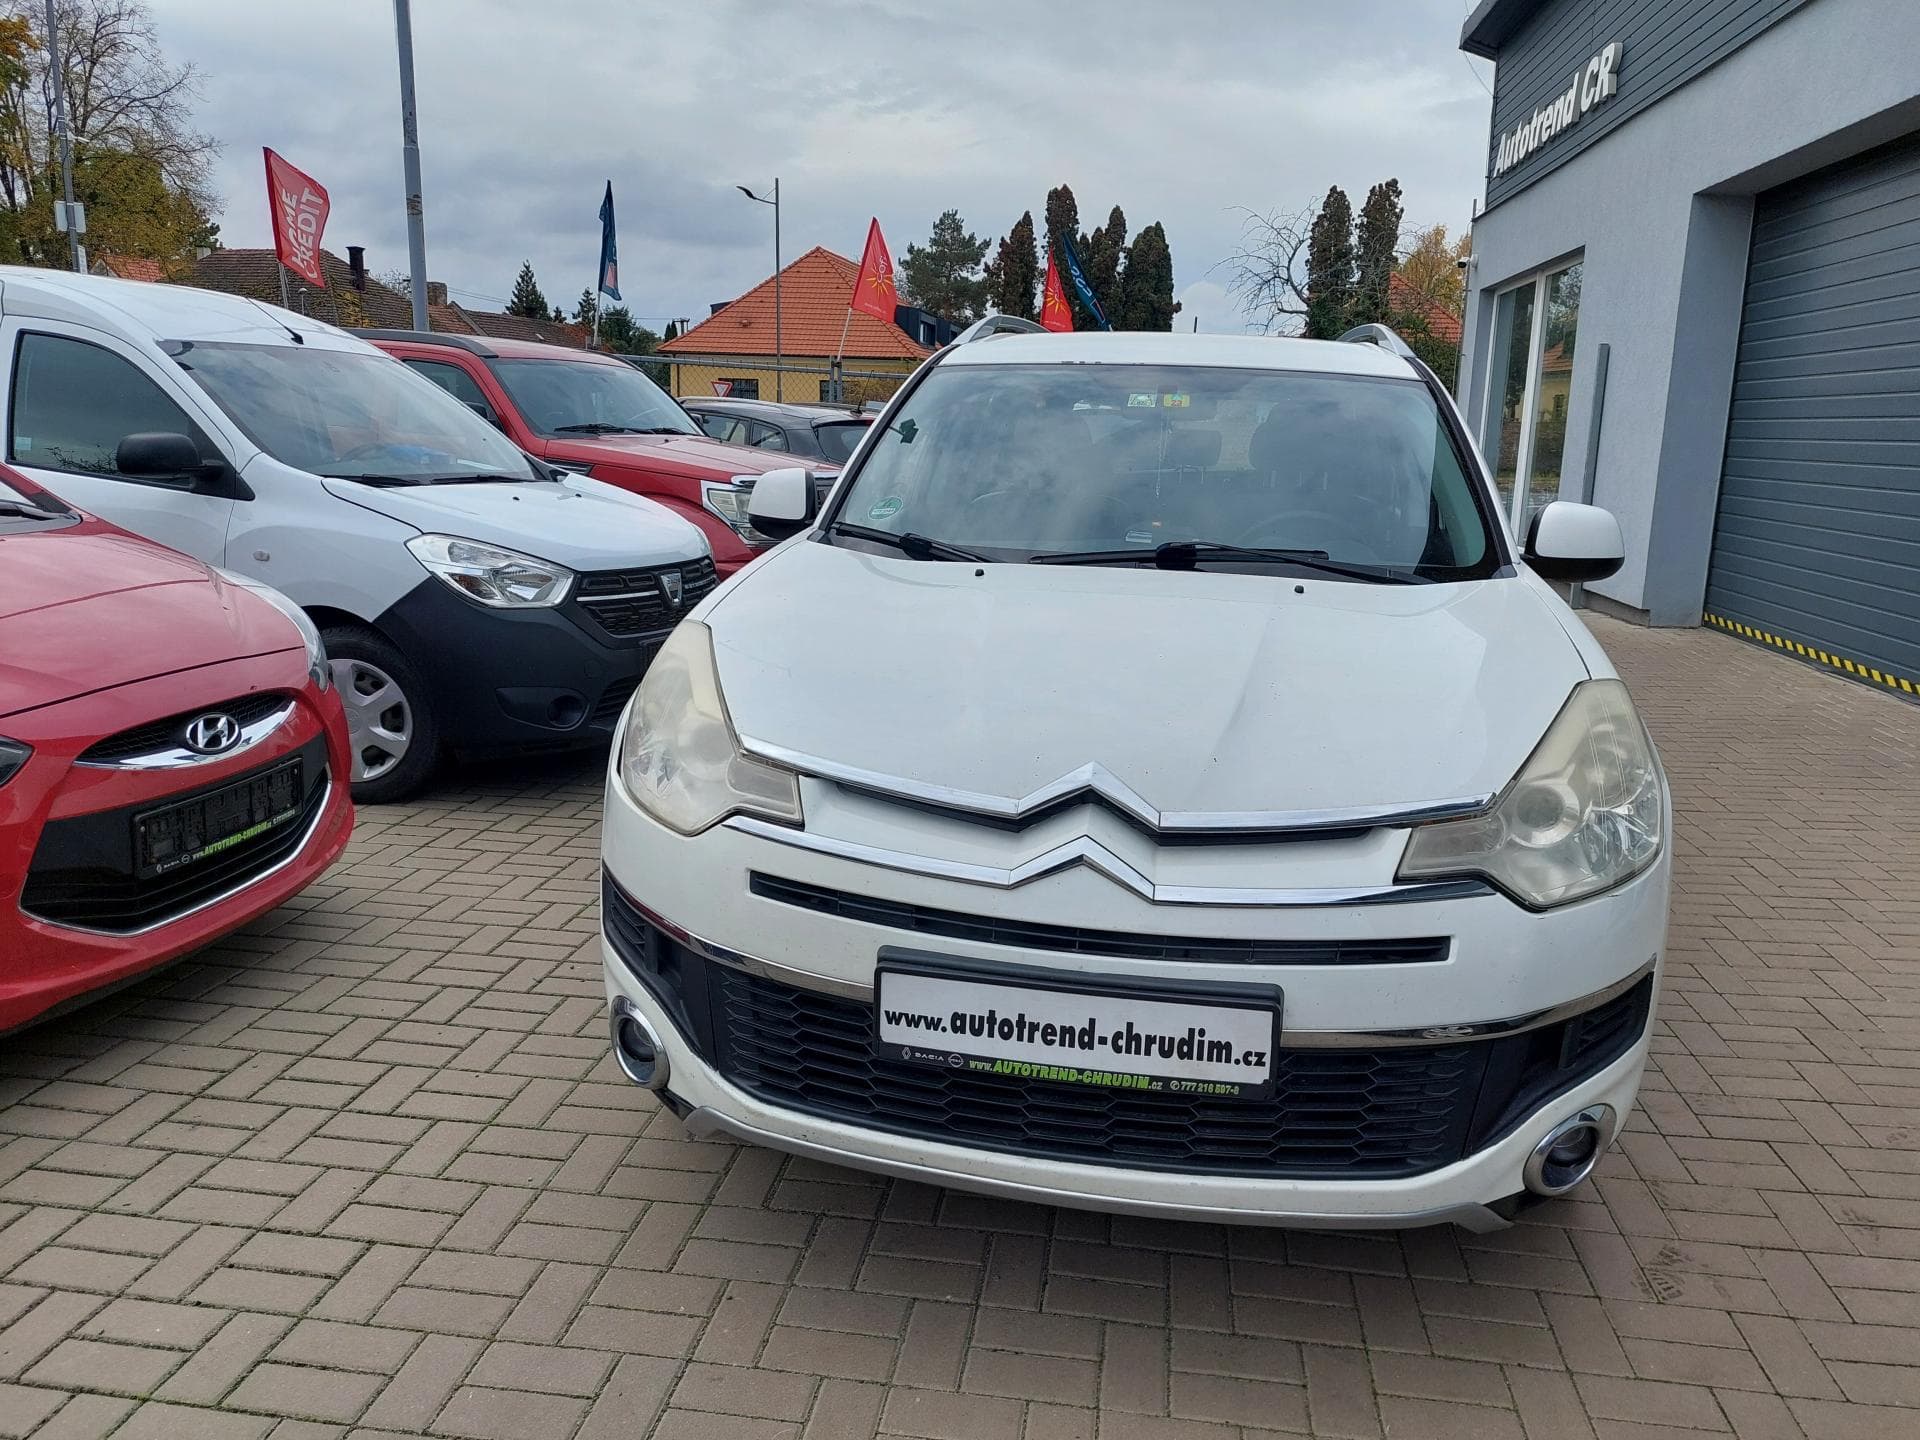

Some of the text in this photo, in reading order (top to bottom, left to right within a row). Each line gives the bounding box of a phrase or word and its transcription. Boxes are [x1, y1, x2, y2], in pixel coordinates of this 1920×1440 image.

[1493, 42, 1622, 178] Autotrend CR
[281, 188, 304, 268] HOME
[297, 187, 323, 279] CREDIT
[884, 1009, 1267, 1068] www.autotrend-chrudim.cz
[969, 1060, 1163, 1090] www.AUTOTREND-CHRUDIM.cz
